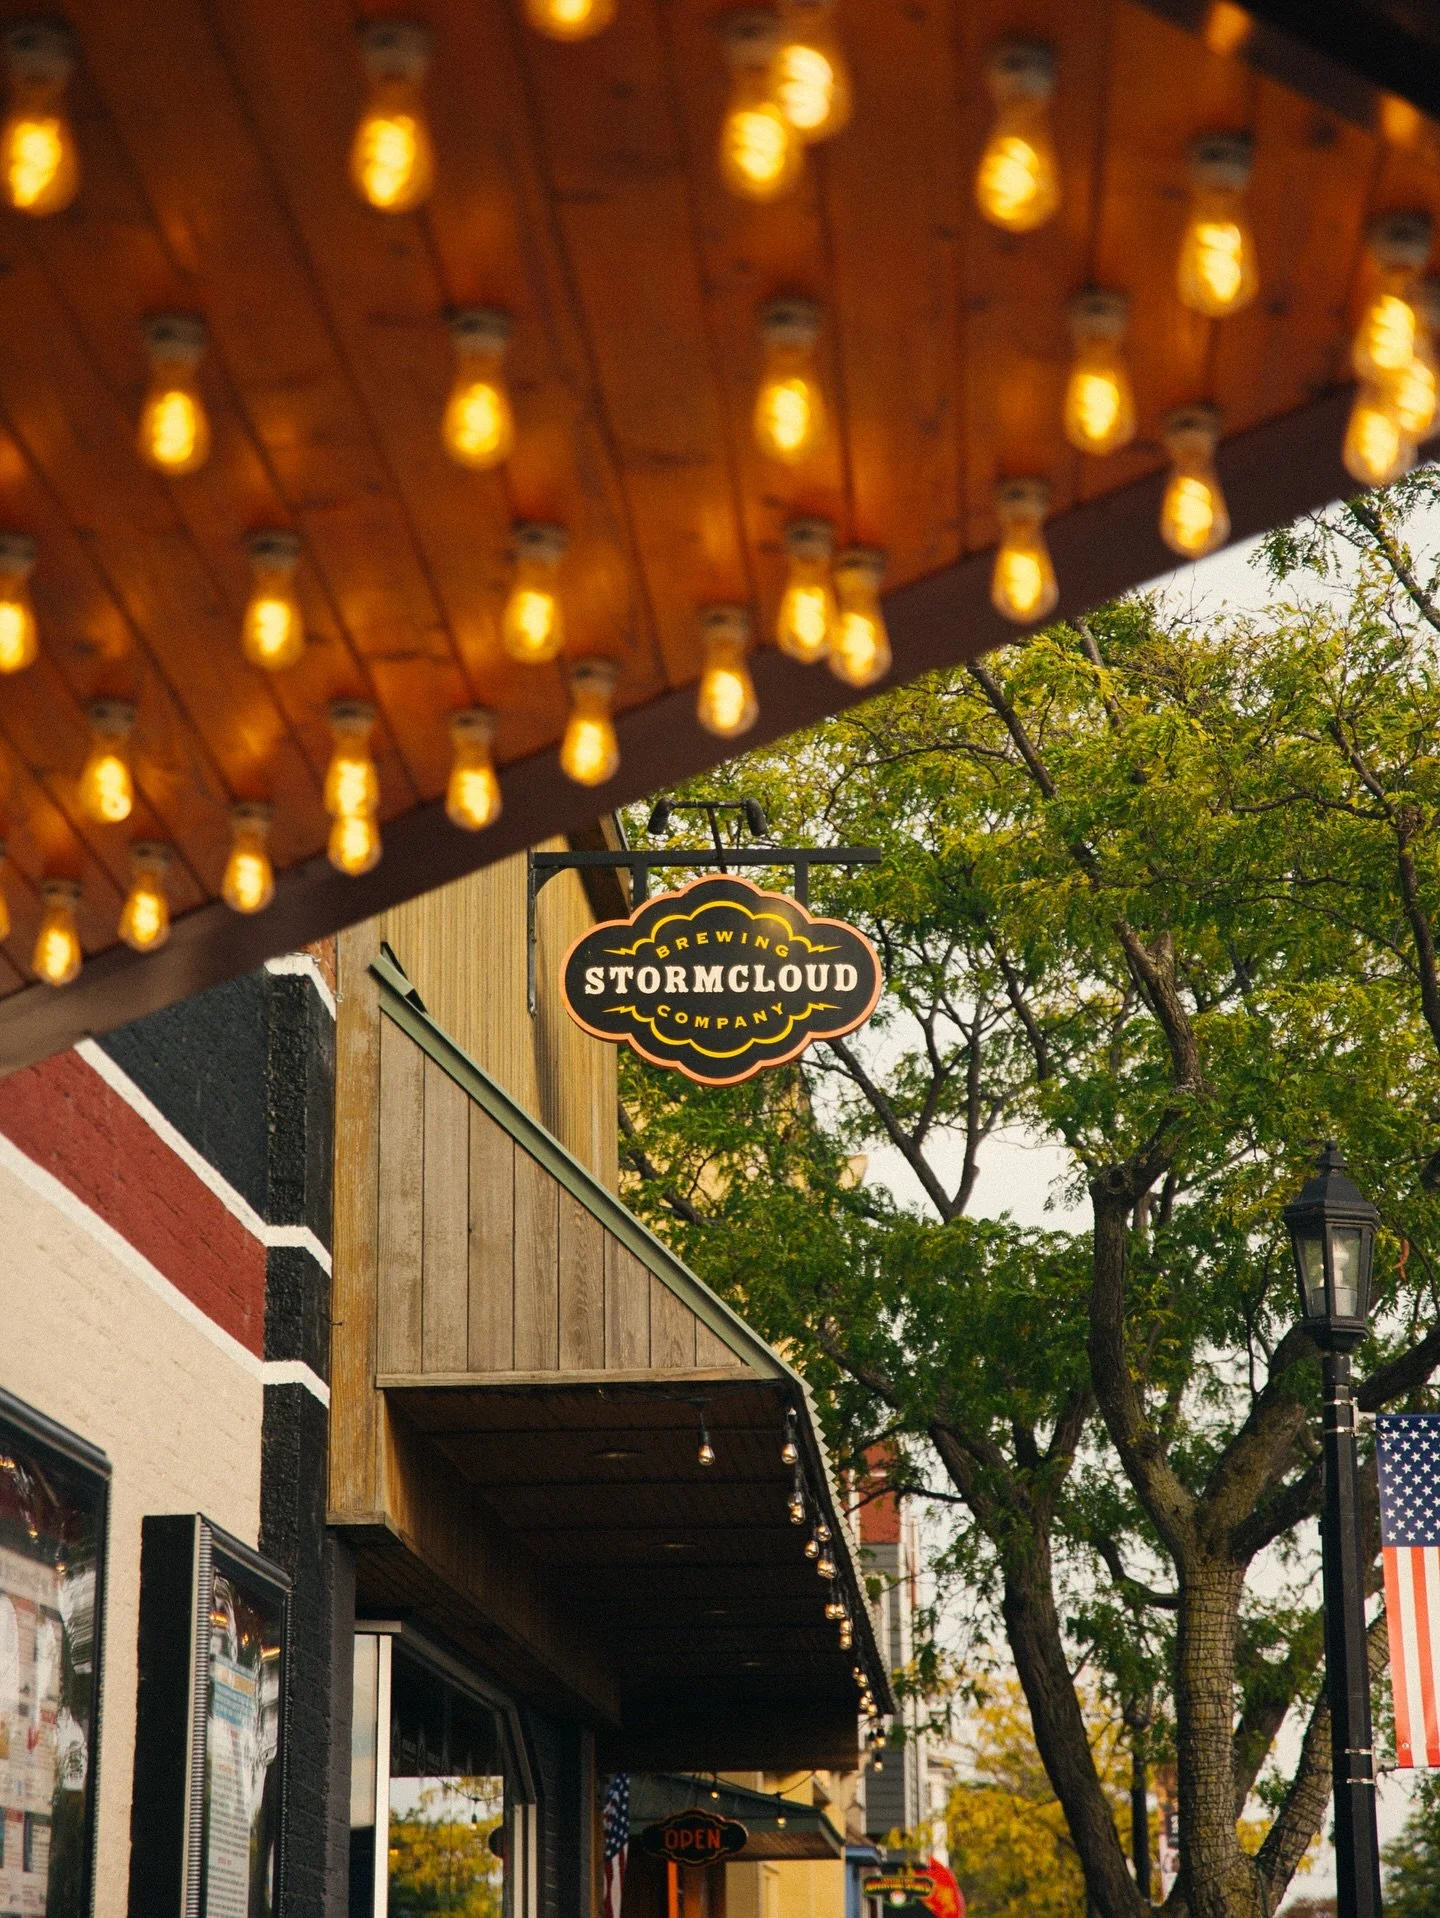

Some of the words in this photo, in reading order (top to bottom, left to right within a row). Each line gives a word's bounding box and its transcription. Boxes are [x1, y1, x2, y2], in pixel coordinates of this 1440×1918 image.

[656, 930, 790, 959] BREWING
[585, 964, 858, 995] STORMCLOUD
[656, 1002, 784, 1030] COMPANY
[664, 1828, 720, 1850] OPEN
